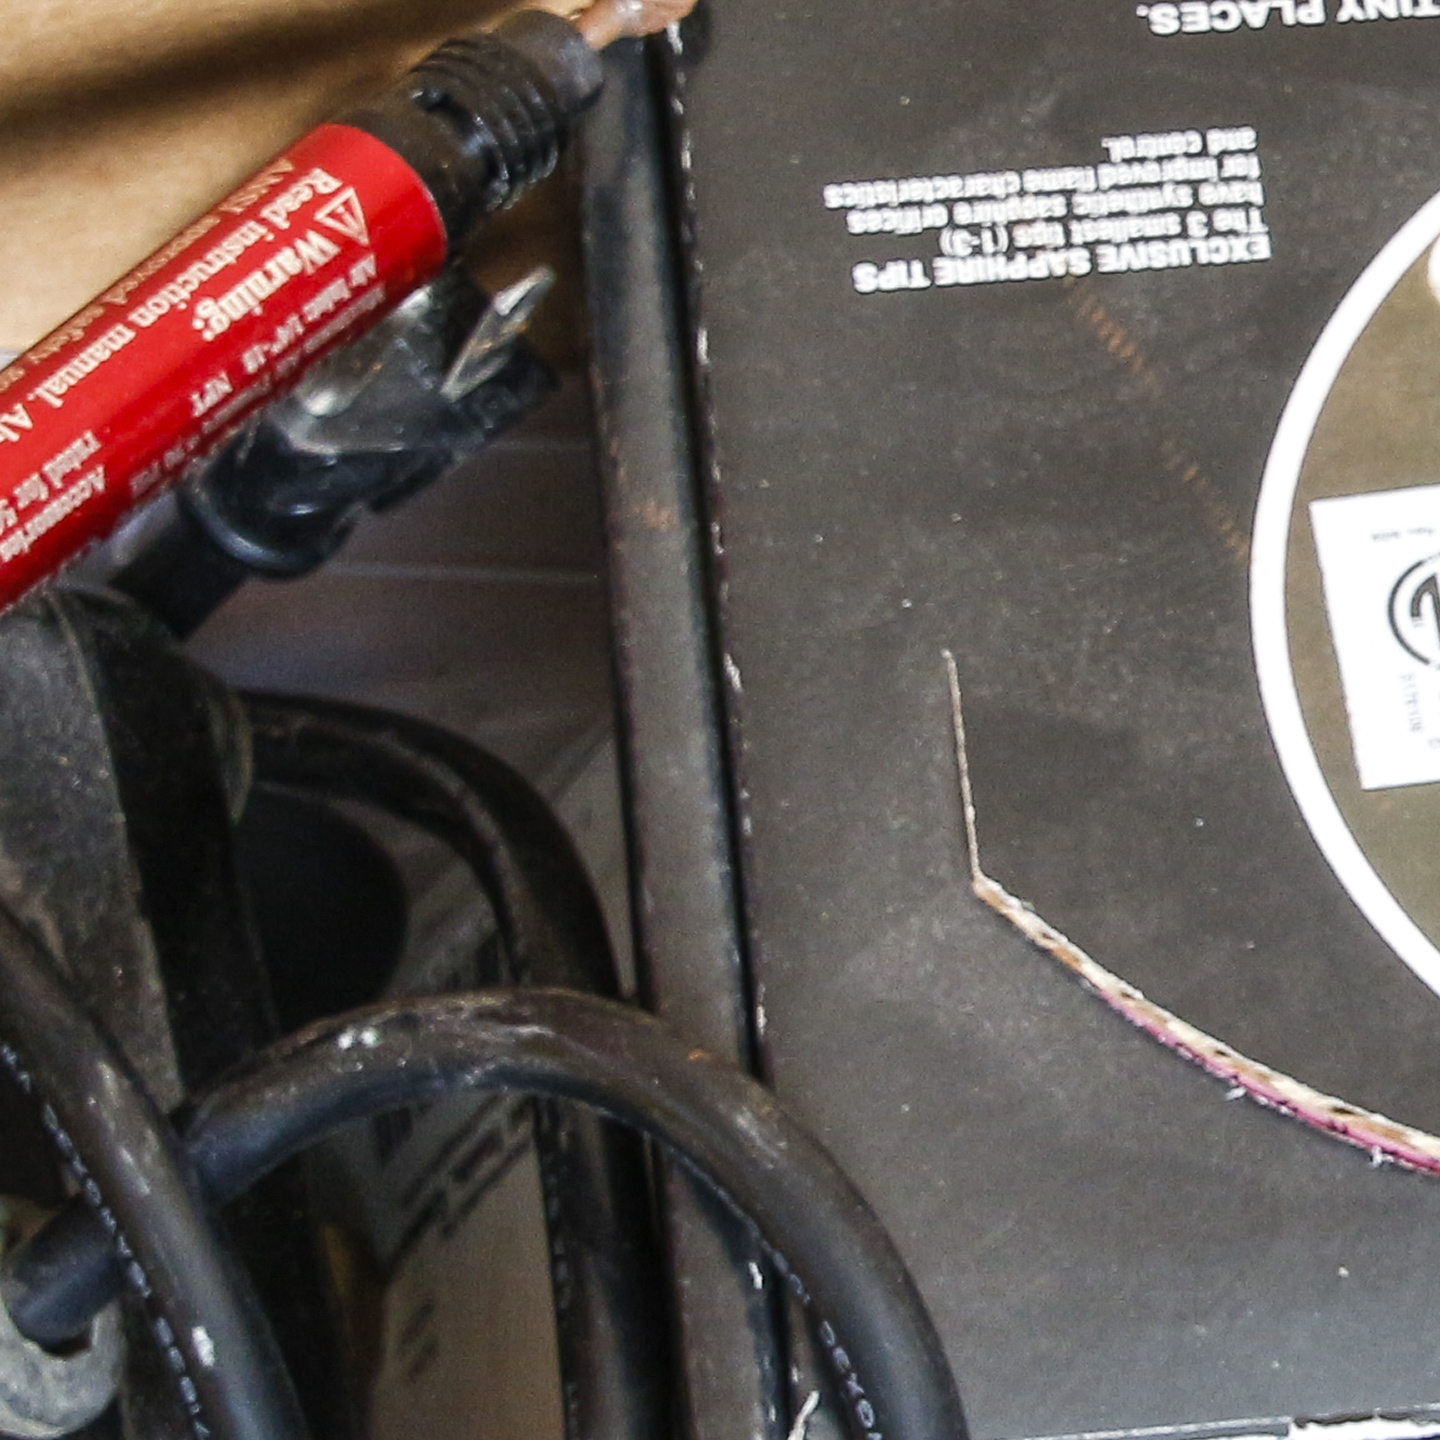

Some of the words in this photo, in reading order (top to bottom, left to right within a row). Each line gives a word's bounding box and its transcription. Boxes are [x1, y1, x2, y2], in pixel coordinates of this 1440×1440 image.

[1101, 130, 1203, 162] control.
[1205, 126, 1256, 154] and
[1021, 165, 1096, 195] flame
[1096, 154, 1218, 189] improved
[1219, 153, 1259, 181] for
[261, 164, 340, 232] Read
[823, 170, 1020, 209] characteristics
[1071, 181, 1194, 218] synthetic
[1197, 180, 1263, 208] have
[845, 203, 950, 236] orifices
[953, 192, 1067, 227] sapphire
[1185, 210, 1209, 237] 3
[1212, 206, 1267, 235] The
[938, 223, 1009, 257] (1-3)
[1011, 218, 1065, 250] tips
[1069, 212, 1181, 245] smallest
[932, 246, 1092, 286] SAPPHIRE
[1095, 232, 1271, 272] EXCLUSIVE
[128, 218, 271, 334] instruction
[189, 221, 335, 344] Warning:
[851, 258, 930, 293] TIPS
[28, 323, 140, 415] manual.
